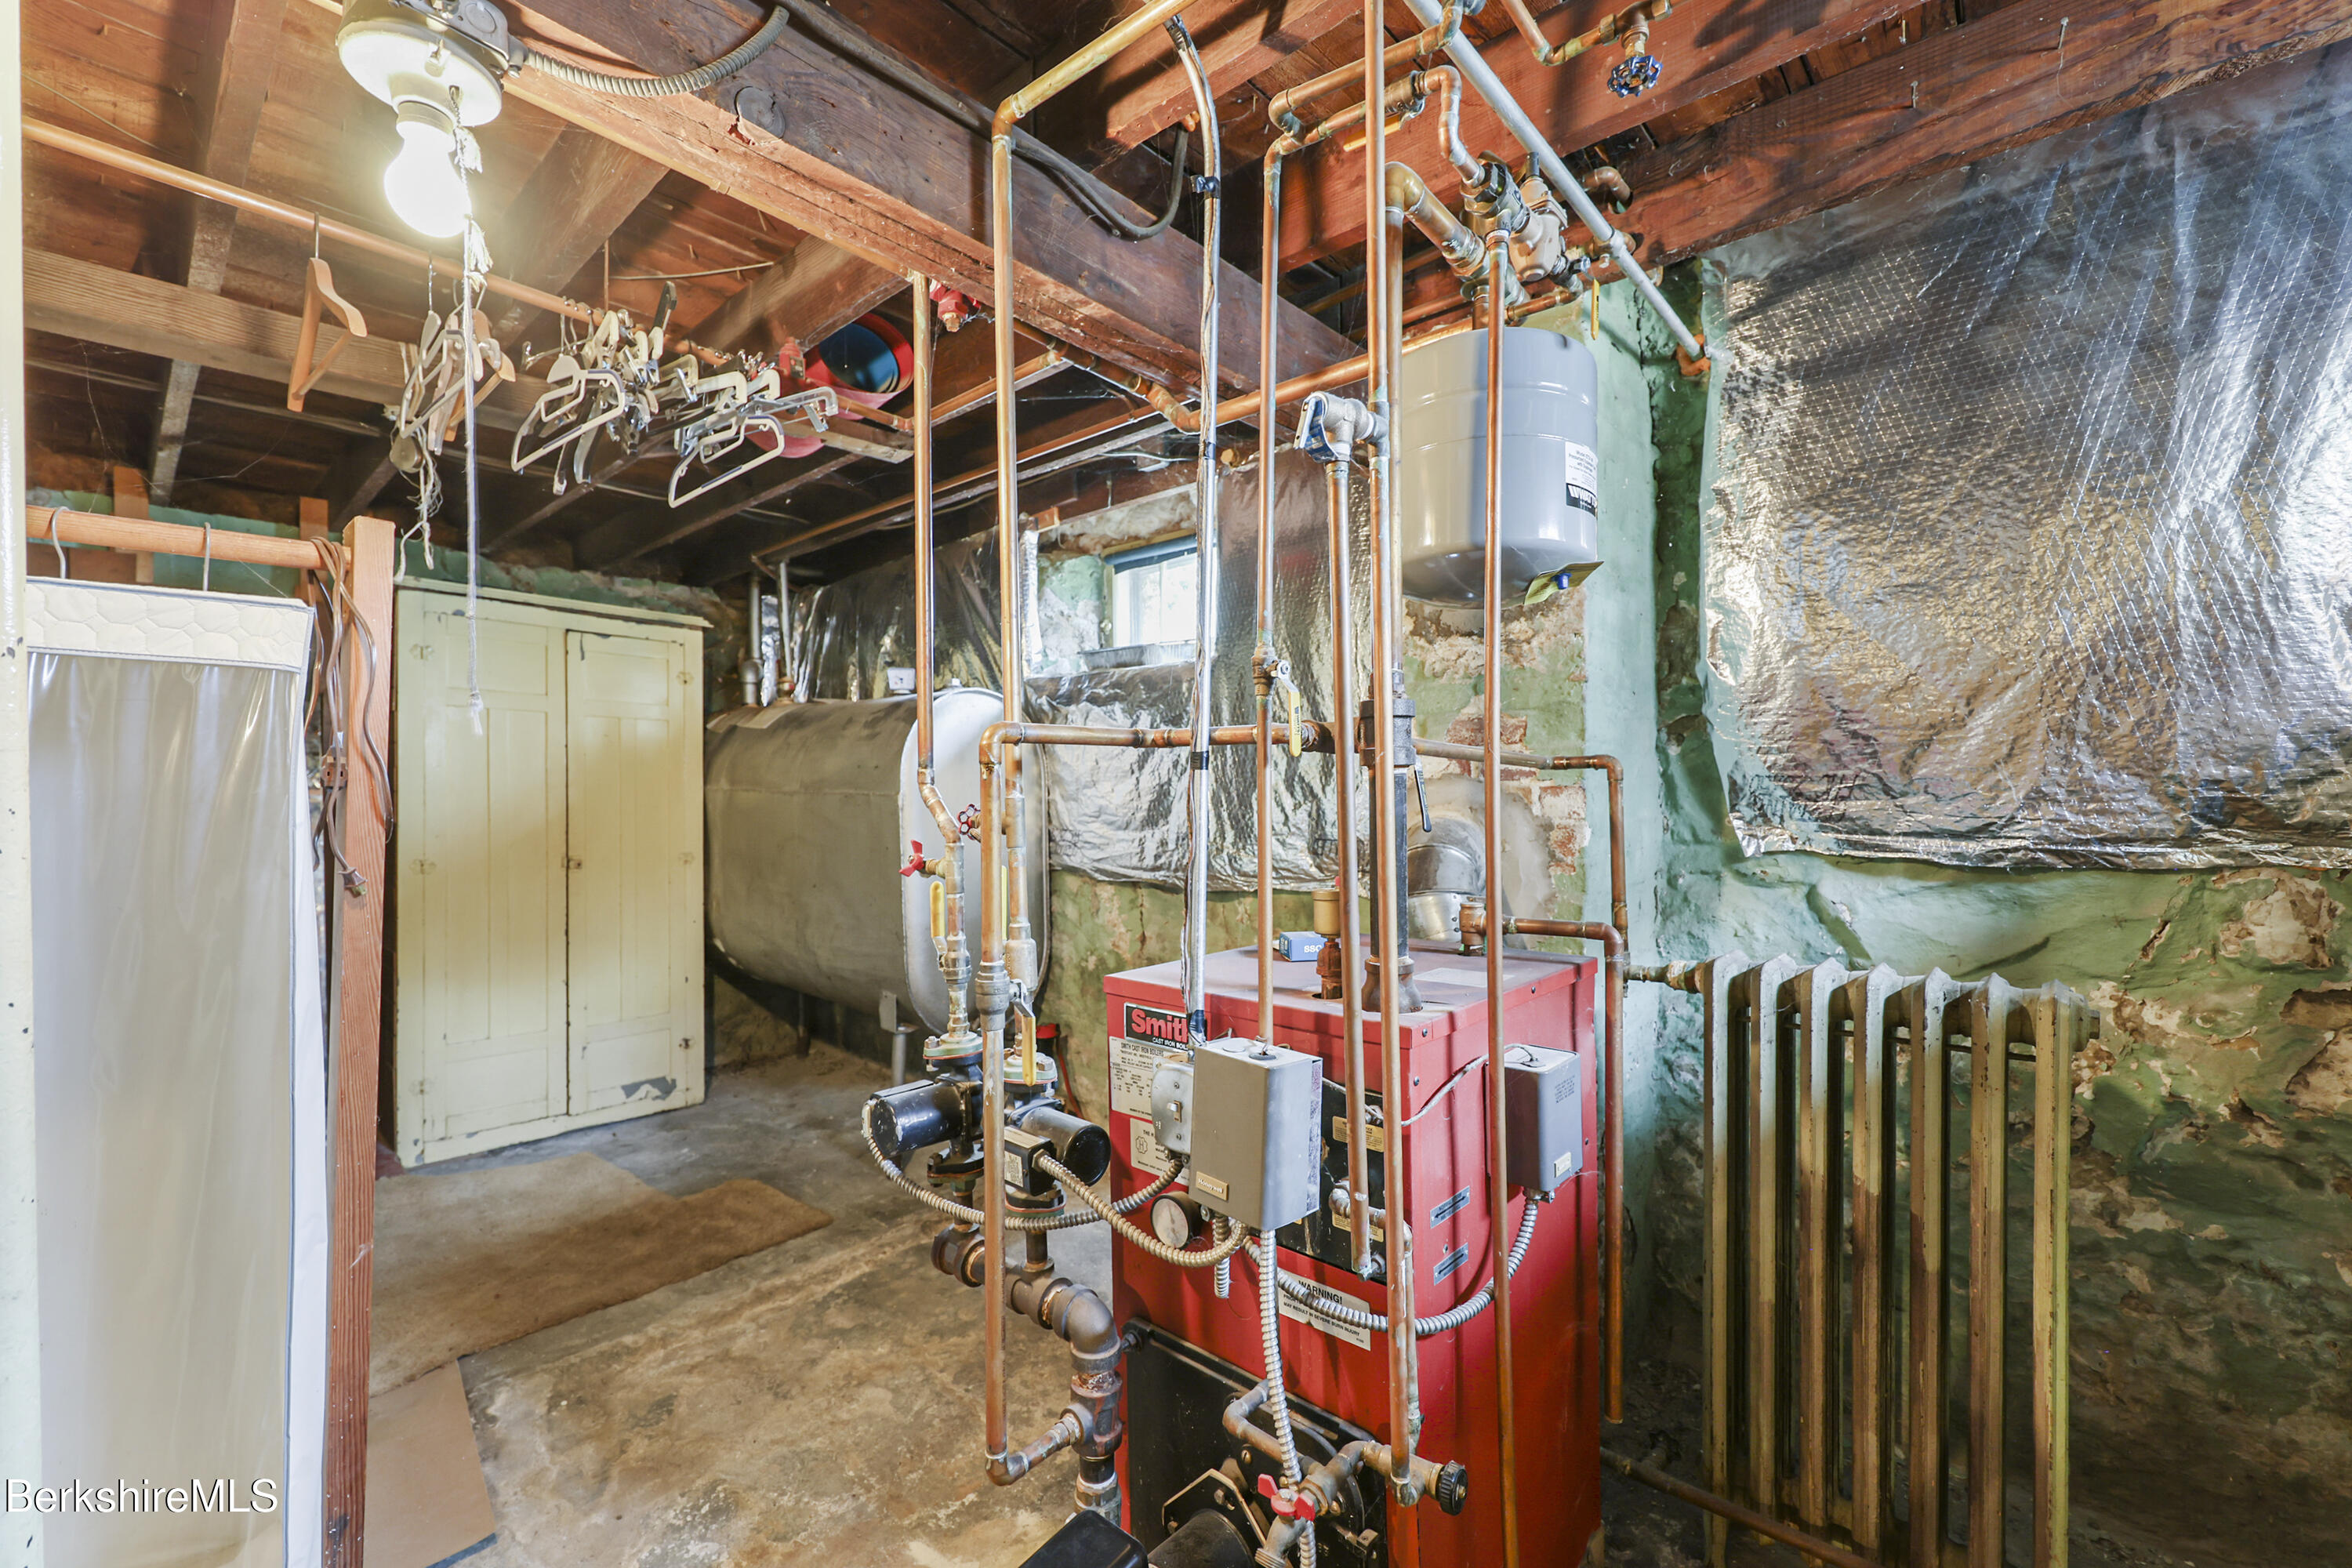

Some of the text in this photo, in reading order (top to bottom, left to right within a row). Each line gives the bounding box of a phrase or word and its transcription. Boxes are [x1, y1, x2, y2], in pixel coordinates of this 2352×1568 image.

[1152, 1036, 1189, 1051] CAST IRON BOIL
[1149, 1047, 1164, 1057] BOILERS
[1198, 1178, 1224, 1193] Honeywell
[1298, 1280, 1343, 1305] WARNING!
[1293, 1305, 1308, 1315] RESULT
[1314, 1314, 1331, 1325] SEVERE
[1331, 1321, 1344, 1330] BURN
[1344, 1327, 1360, 1337] INJURY
